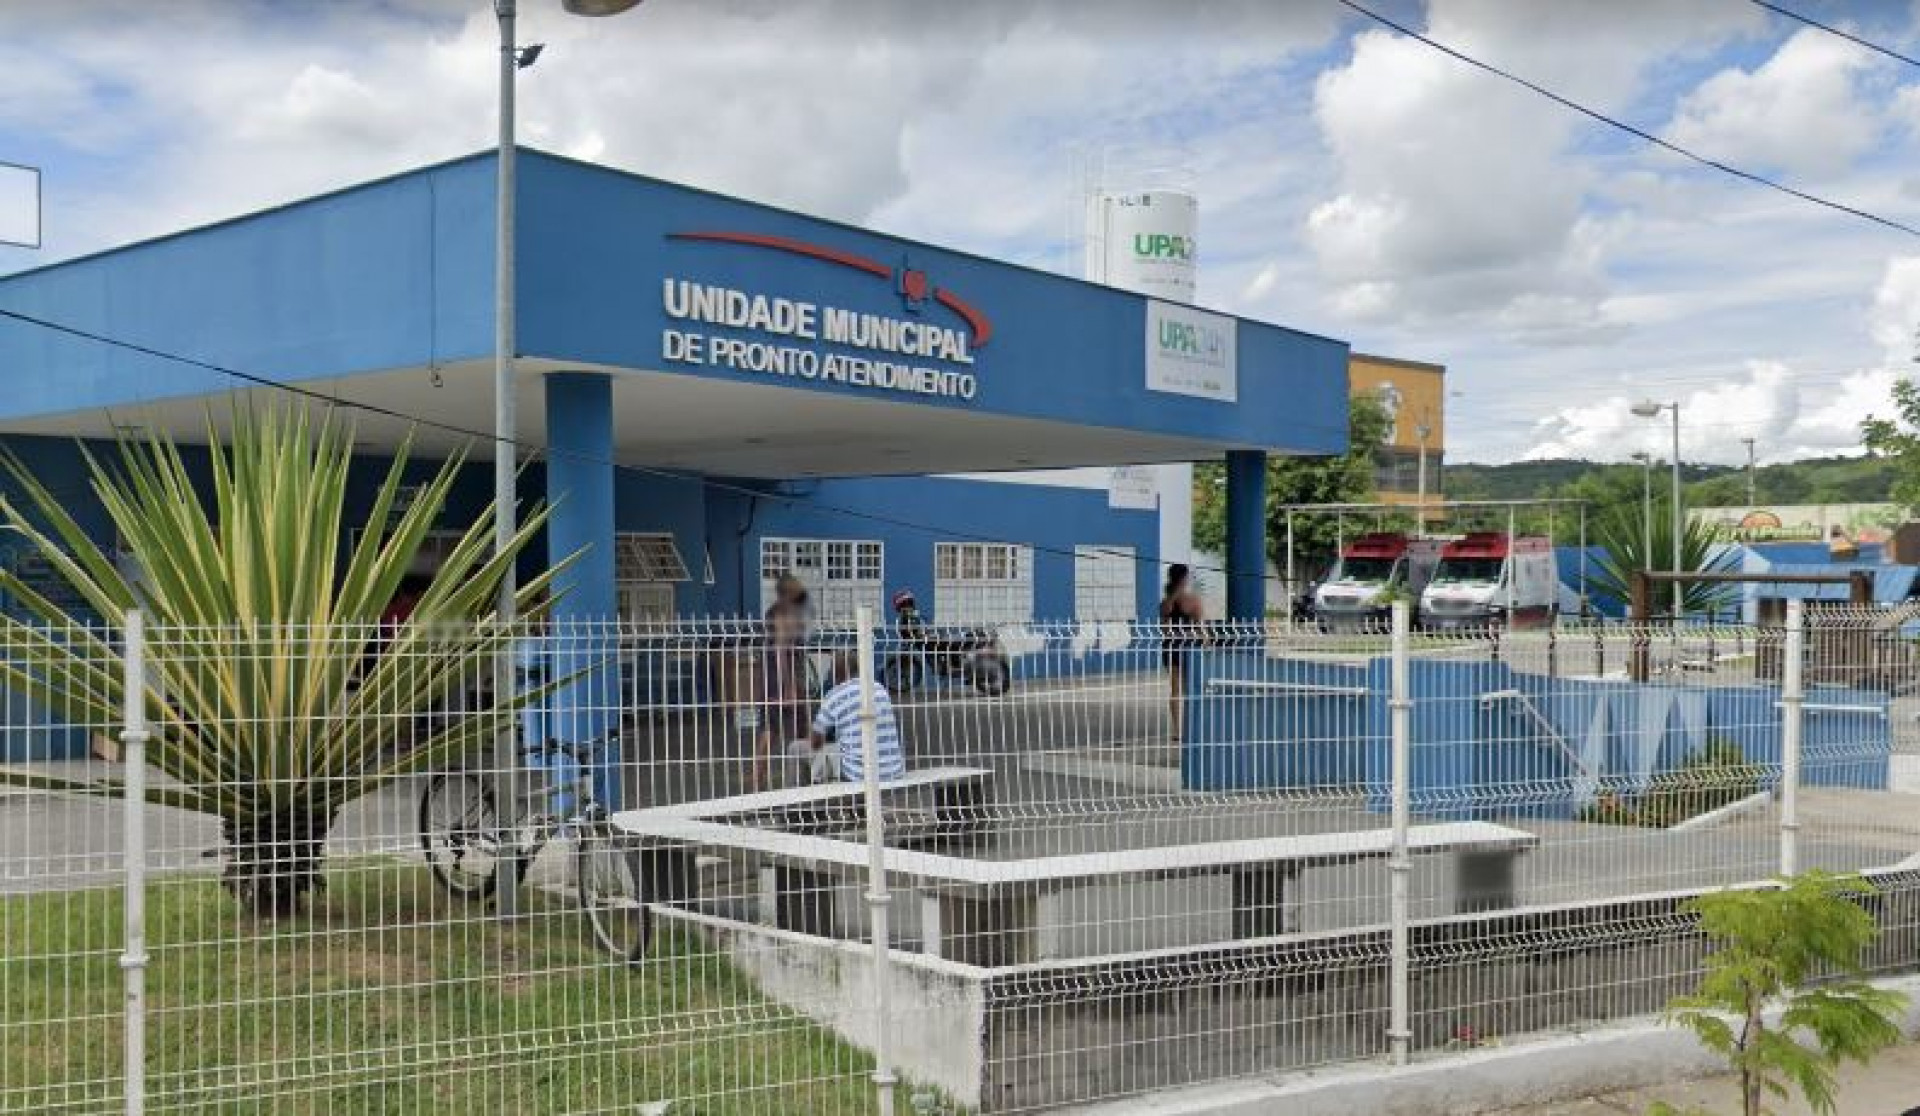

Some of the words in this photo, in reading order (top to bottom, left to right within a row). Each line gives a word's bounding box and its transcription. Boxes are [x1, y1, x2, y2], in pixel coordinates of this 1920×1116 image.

[664, 278, 816, 338] UNIDADE
[822, 307, 974, 363] MUNICIPAL
[663, 329, 703, 363] DE
[708, 337, 819, 378] PRONTO
[820, 353, 976, 398] ATENDIMENTO
